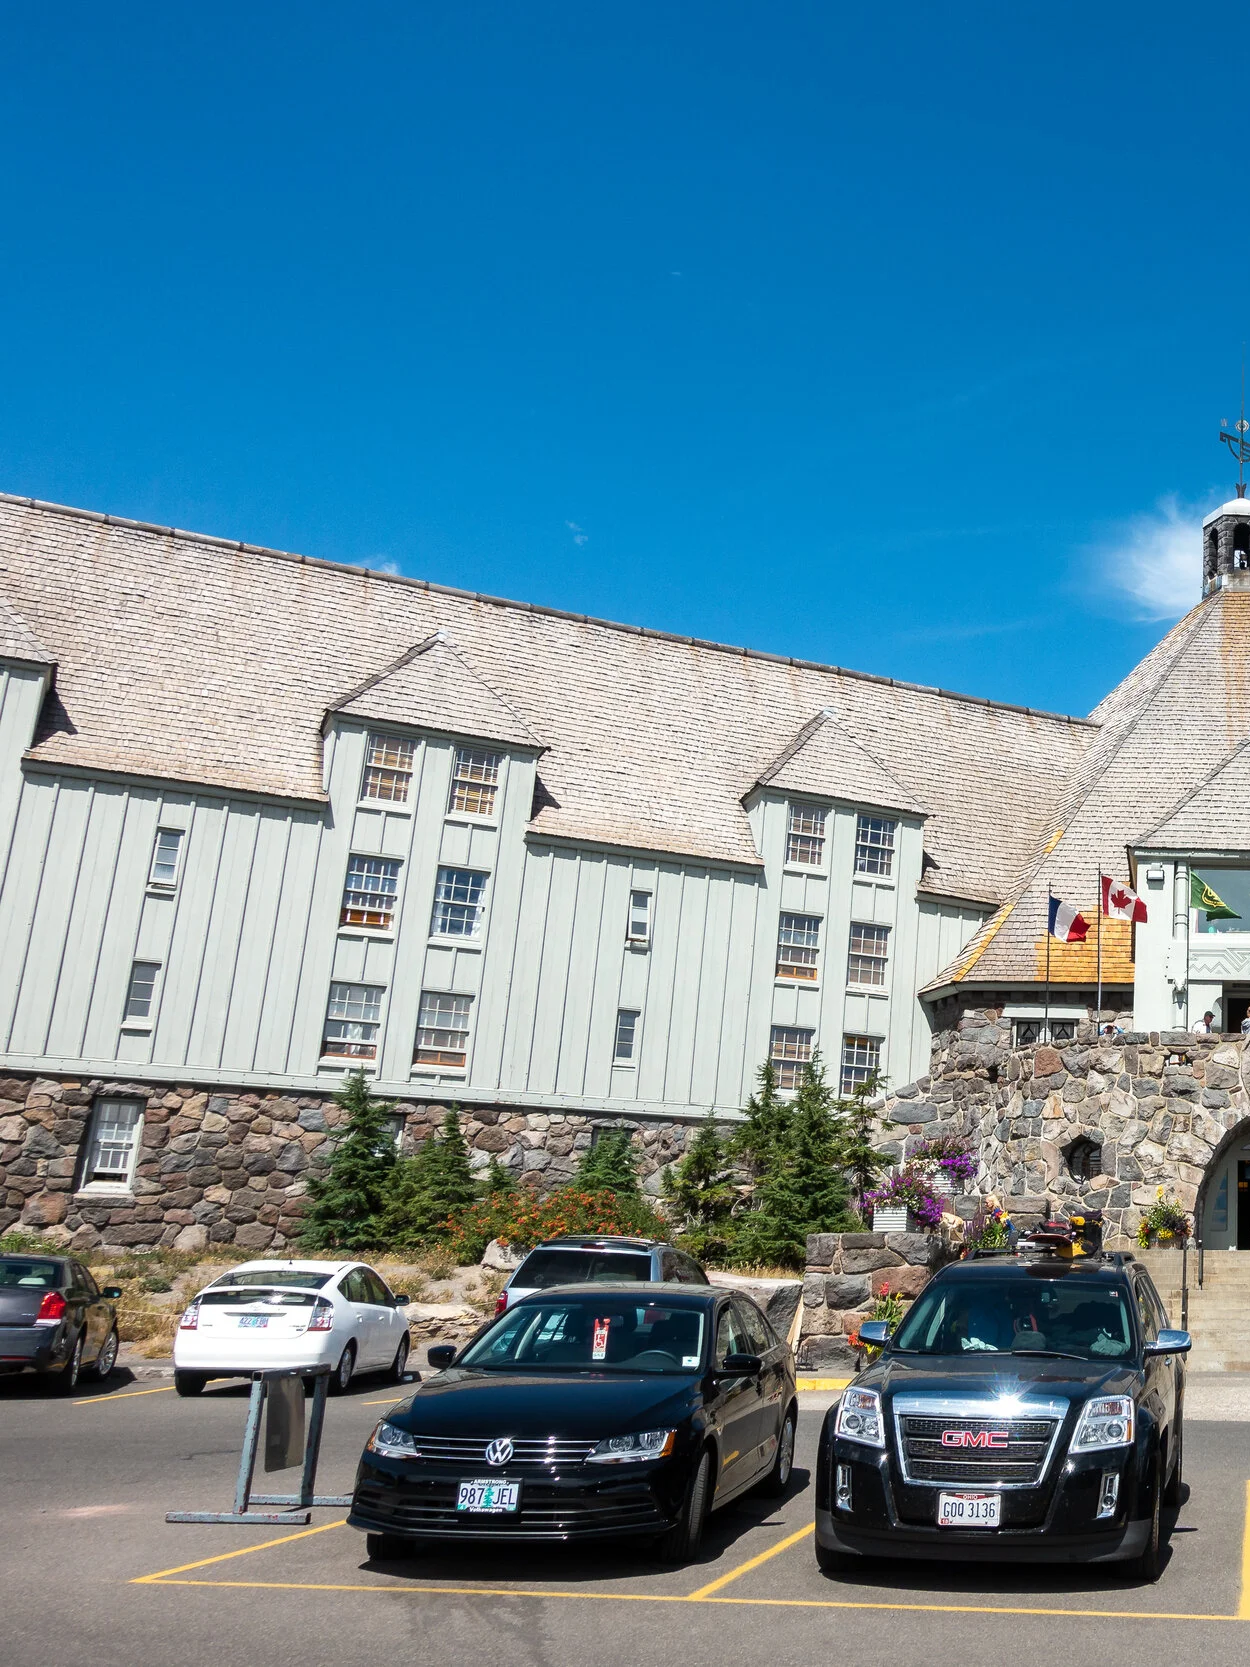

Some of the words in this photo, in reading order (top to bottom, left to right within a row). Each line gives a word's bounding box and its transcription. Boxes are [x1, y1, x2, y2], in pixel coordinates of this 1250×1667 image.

[942, 1430, 1009, 1448] GMC
[460, 1487, 485, 1505] 987
[492, 1488, 516, 1505] JEL
[968, 1502, 996, 1519] 3136
